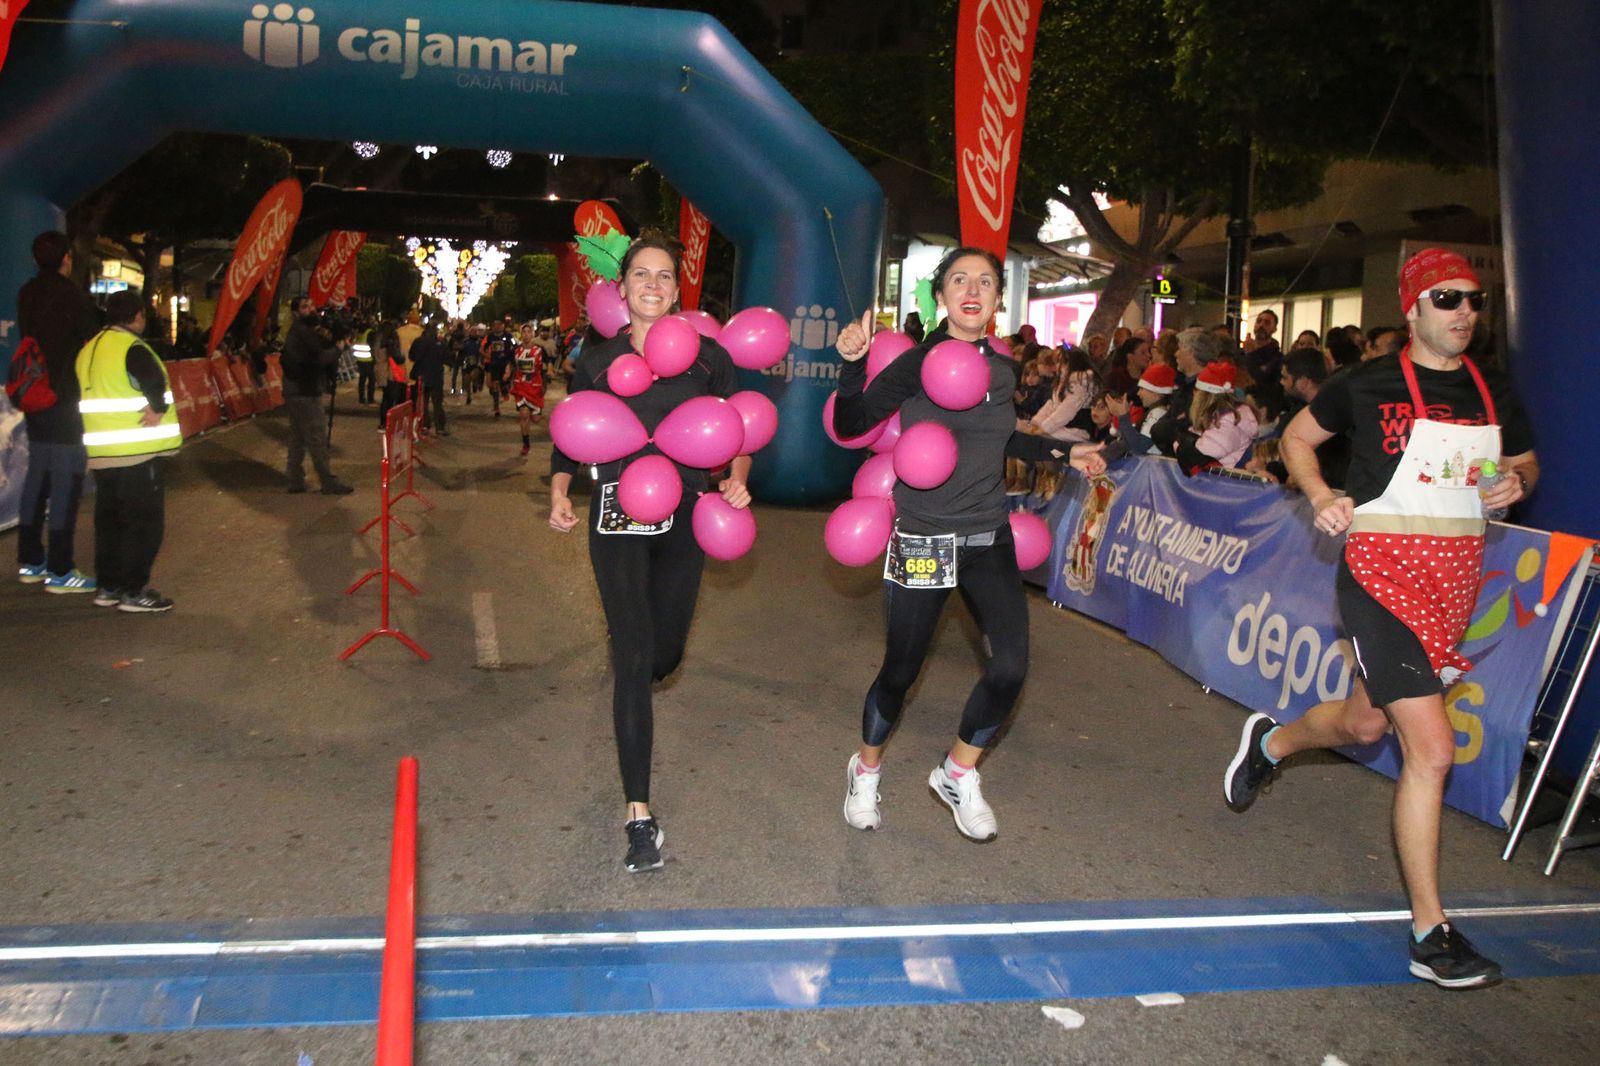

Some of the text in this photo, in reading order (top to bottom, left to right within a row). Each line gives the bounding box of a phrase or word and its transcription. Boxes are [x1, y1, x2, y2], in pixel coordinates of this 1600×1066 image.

[337, 17, 578, 80] cajamar
[456, 73, 569, 96] CAJA RURAL
[1116, 504, 1249, 575] AYUNTAMIENTO
[905, 558, 937, 574] 689
[1105, 542, 1129, 577] DE
